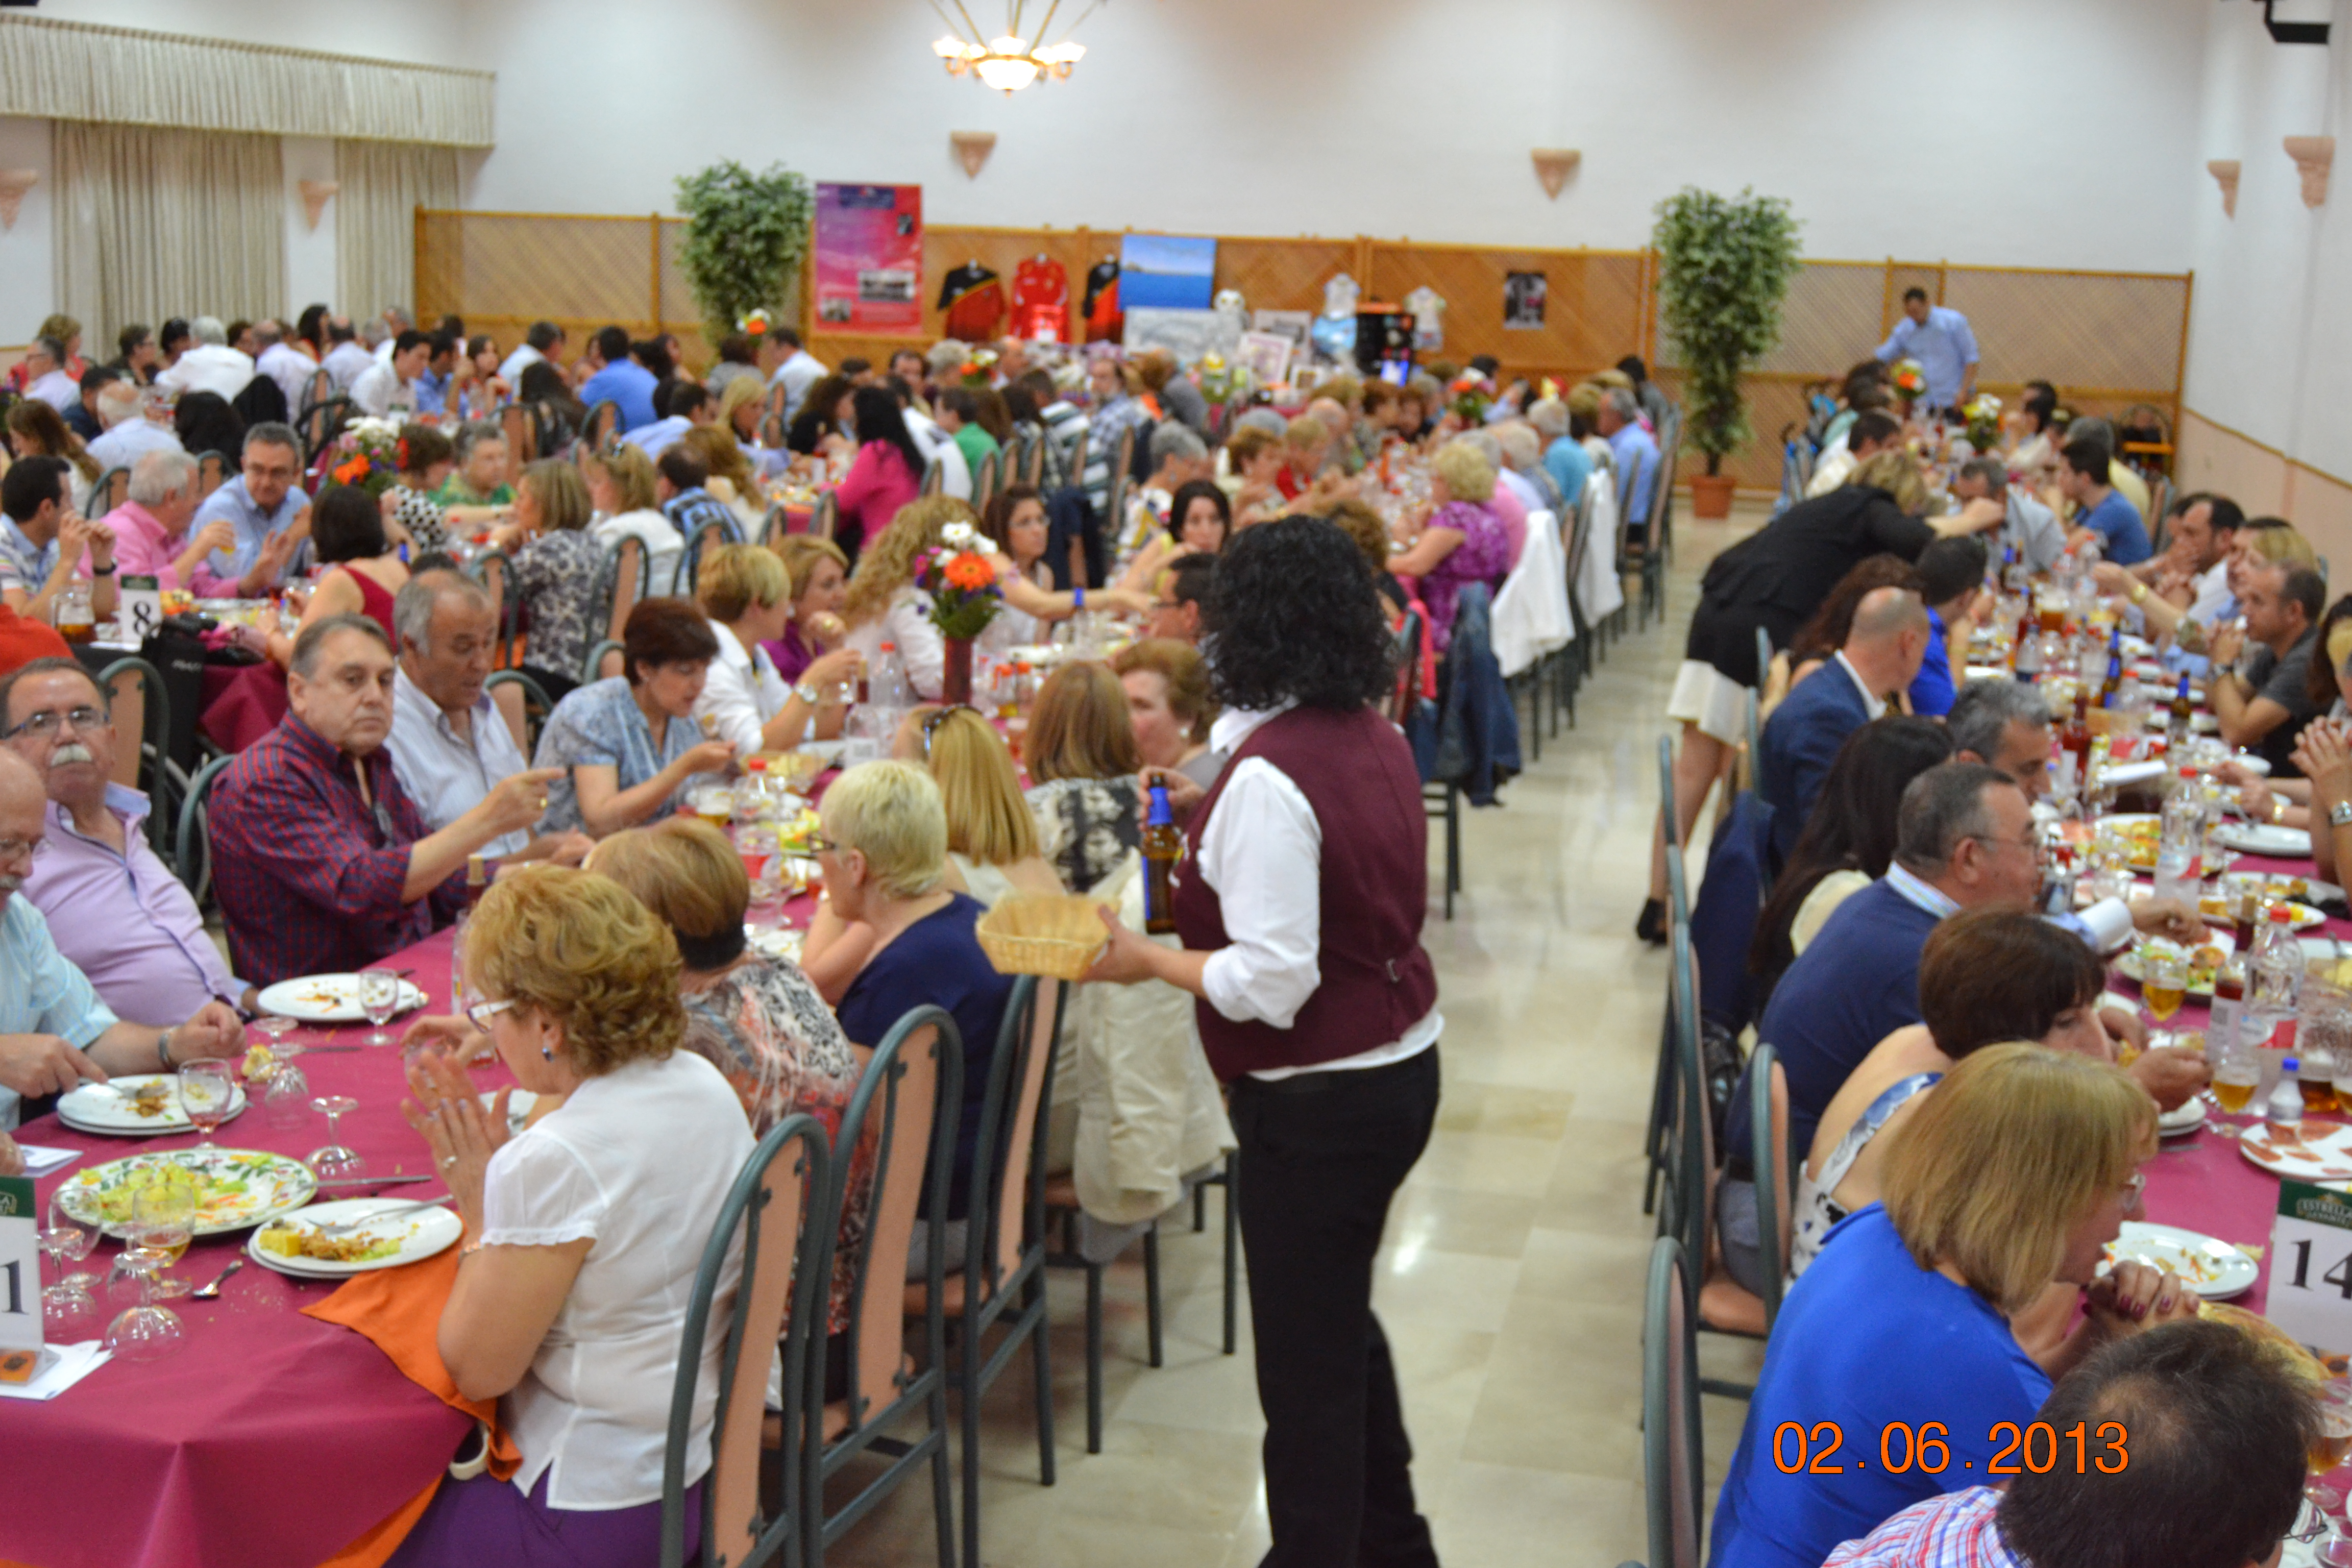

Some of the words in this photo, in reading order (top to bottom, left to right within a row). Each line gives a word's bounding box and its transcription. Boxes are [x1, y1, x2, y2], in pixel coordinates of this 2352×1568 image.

[134, 601, 151, 636] 8
[0, 1259, 29, 1315] 1
[2286, 1239, 2352, 1300] 14
